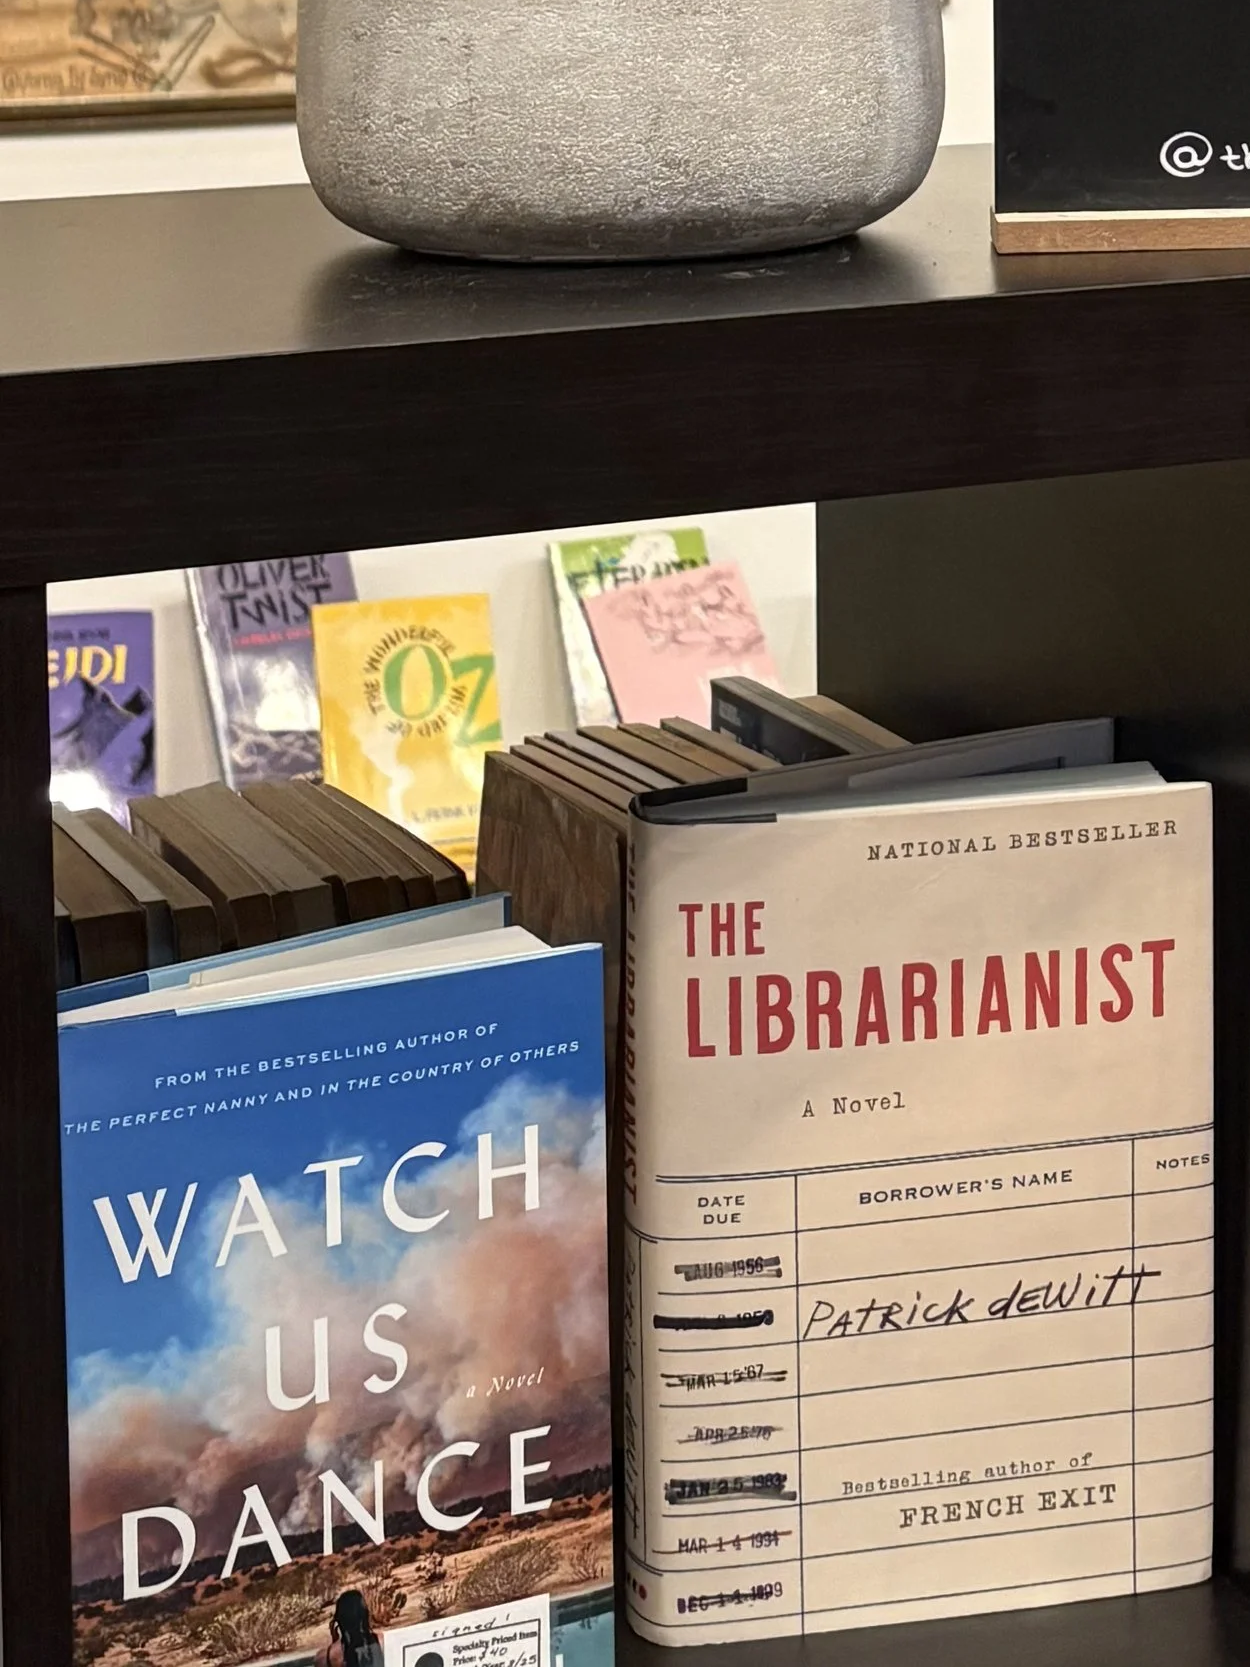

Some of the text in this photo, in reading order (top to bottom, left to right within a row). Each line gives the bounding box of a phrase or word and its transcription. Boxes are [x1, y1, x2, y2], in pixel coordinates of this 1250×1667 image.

[867, 819, 1179, 862] NATIONAL BESTSELLER
[678, 901, 765, 958] THE
[686, 938, 1176, 1058] LIBRARIANIST
[155, 1022, 499, 1089] FROM THE BESTSELLING AUTHOR OF
[64, 1040, 580, 1136] THE PERFECT NANNY AND IN THE COUNTRY OF OTHERS
[801, 1091, 907, 1119] A Novel
[1155, 1152, 1211, 1171] NOTES
[93, 1124, 541, 1284] WATCH
[697, 1195, 746, 1209] DATE
[859, 1169, 1074, 1206] BORROWER'S NAME
[703, 1213, 742, 1226] DUE
[465, 1366, 545, 1399] a Novel
[842, 1452, 1093, 1496] Bestselling author of
[122, 1425, 554, 1602] DANCE
[899, 1483, 1117, 1529] FRENCH EXIT
[678, 1538, 708, 1554] MAR
[452, 1640, 489, 1655] Specialty
[491, 1632, 518, 1646] Priced
